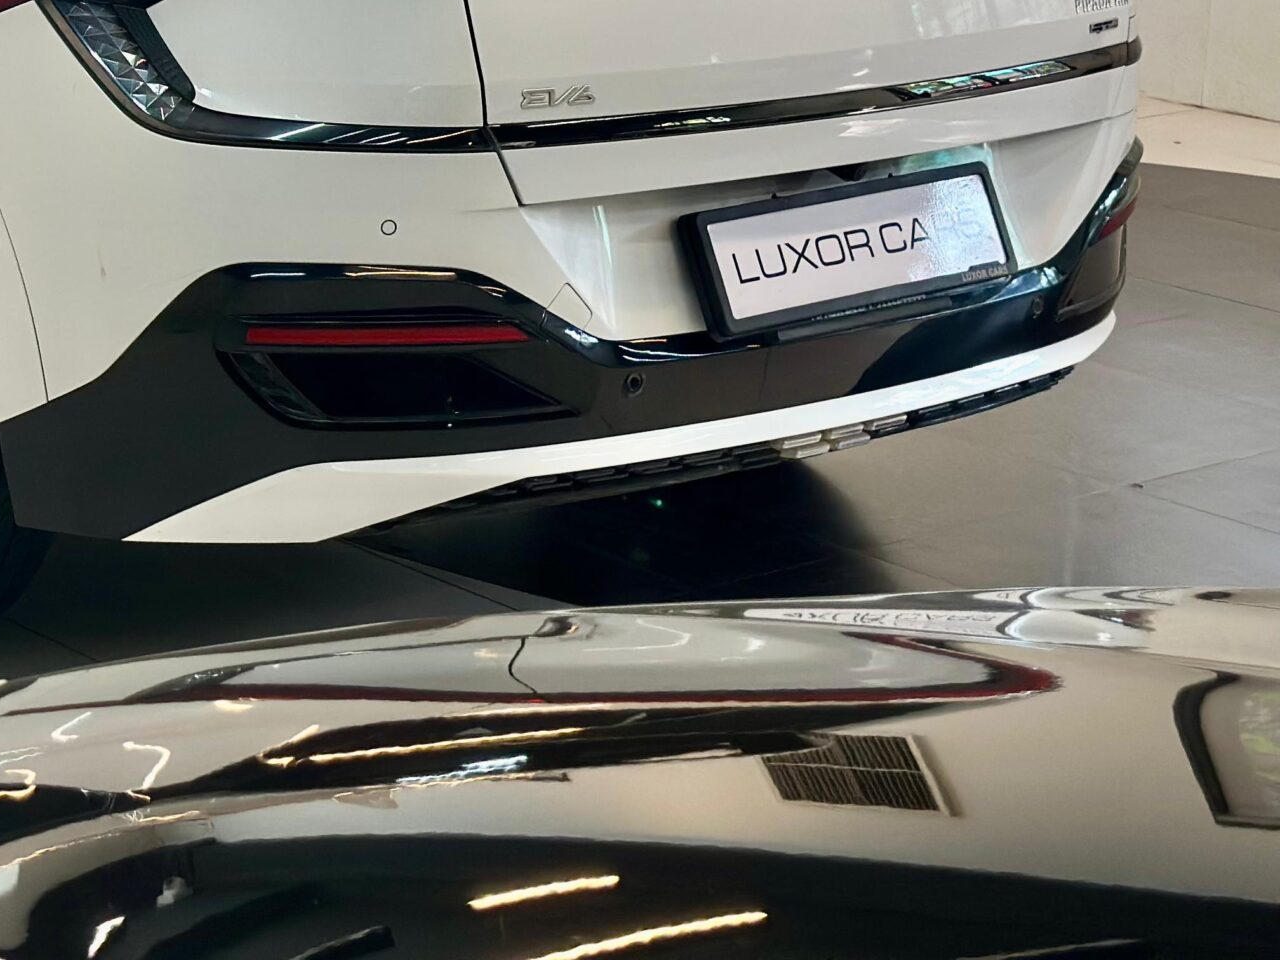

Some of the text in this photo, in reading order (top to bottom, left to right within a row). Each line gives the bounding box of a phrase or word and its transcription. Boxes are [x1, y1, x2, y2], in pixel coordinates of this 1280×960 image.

[520, 84, 596, 109] EV6
[731, 227, 875, 285] LUXOR
[961, 265, 1008, 282] LUXOR CARS
